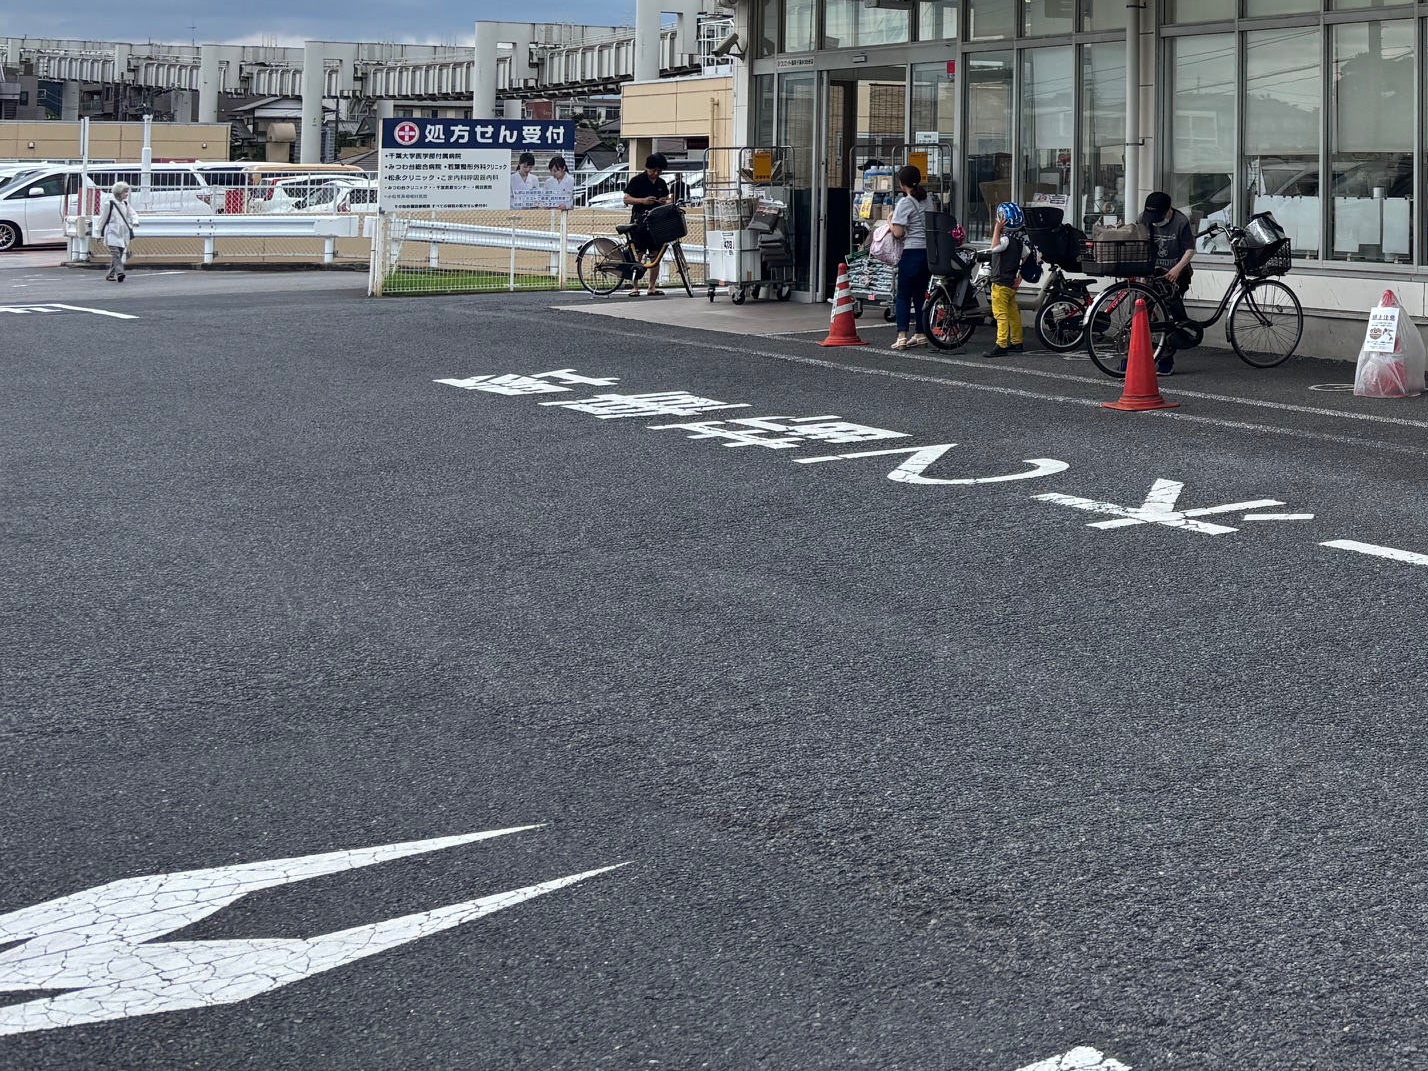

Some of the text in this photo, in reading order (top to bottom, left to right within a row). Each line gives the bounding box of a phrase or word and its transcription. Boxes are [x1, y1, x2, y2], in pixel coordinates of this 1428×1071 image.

[424, 124, 565, 145] 処方せん受付
